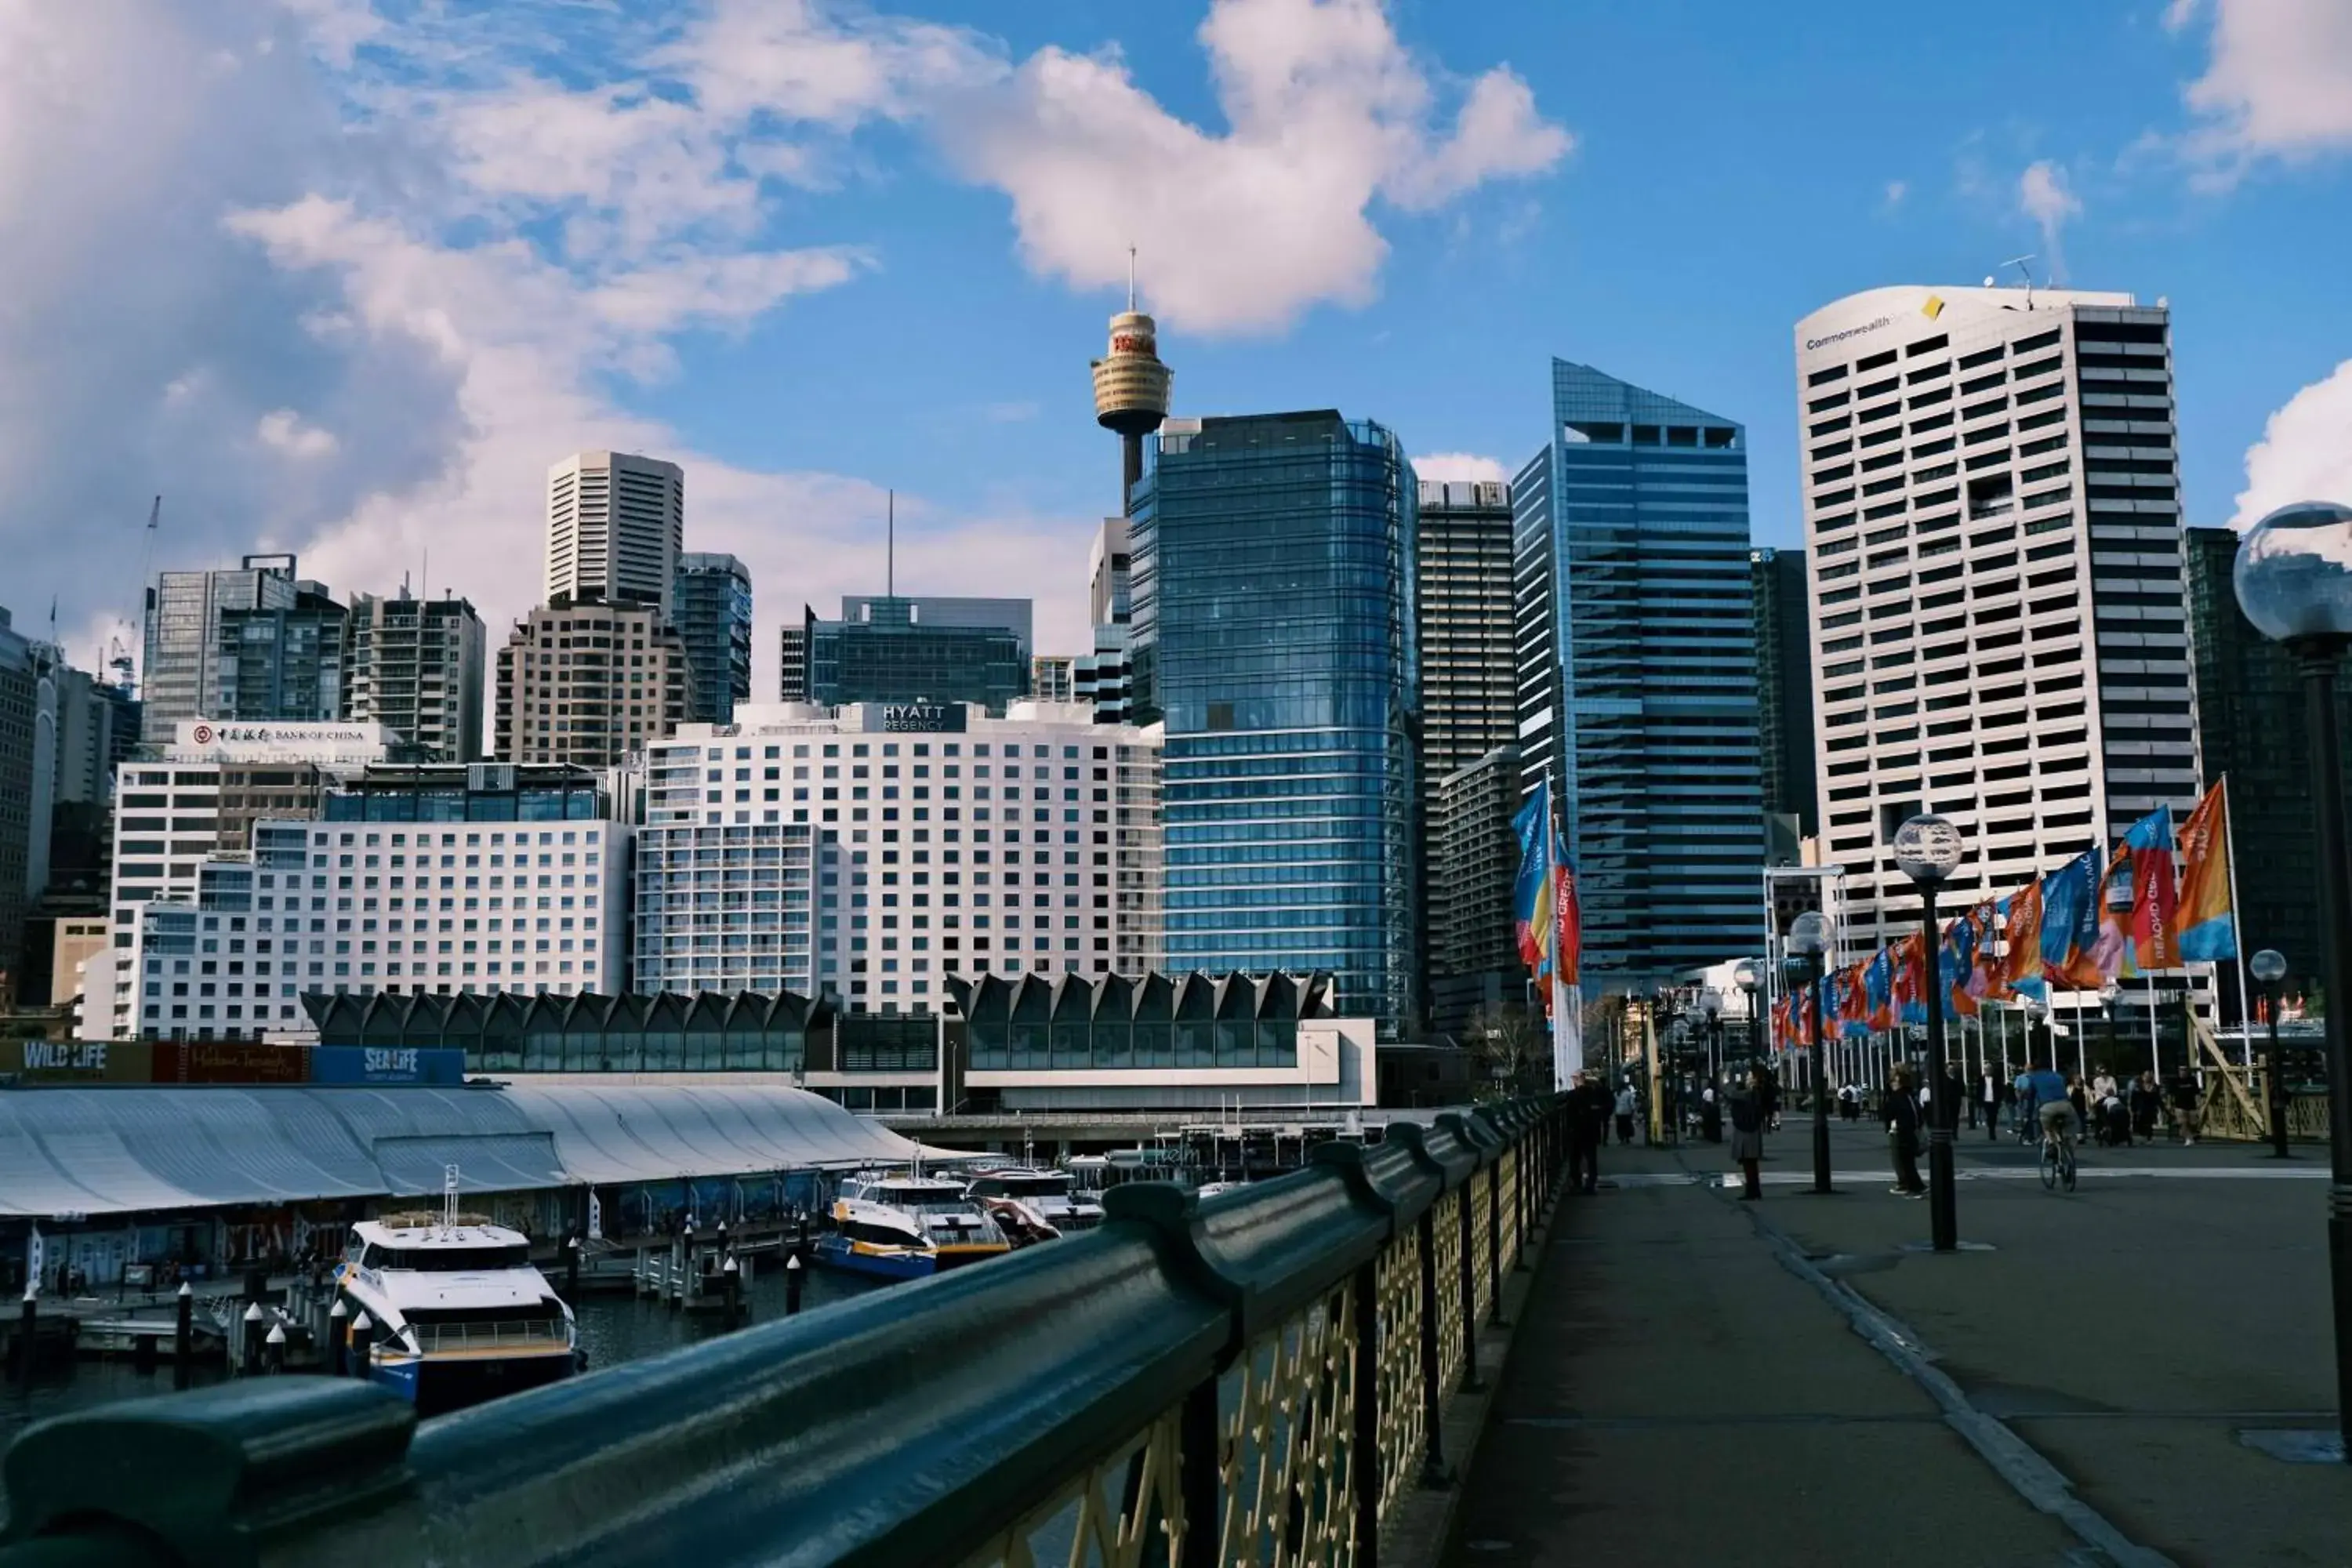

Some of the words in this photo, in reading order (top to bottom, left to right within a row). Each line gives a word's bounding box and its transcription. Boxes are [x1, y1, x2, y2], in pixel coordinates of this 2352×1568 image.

[1806, 316, 1890, 350] Commonwealth
[884, 706, 945, 718] HYATT
[275, 730, 307, 740] BANK
[310, 730, 325, 740] OF
[326, 730, 365, 740] CHINA
[884, 720, 943, 731] REGENCY
[24, 1041, 68, 1069] WILD
[72, 1043, 107, 1069] LIFE
[365, 1047, 390, 1073] SEA
[392, 1047, 419, 1073] LIFE
